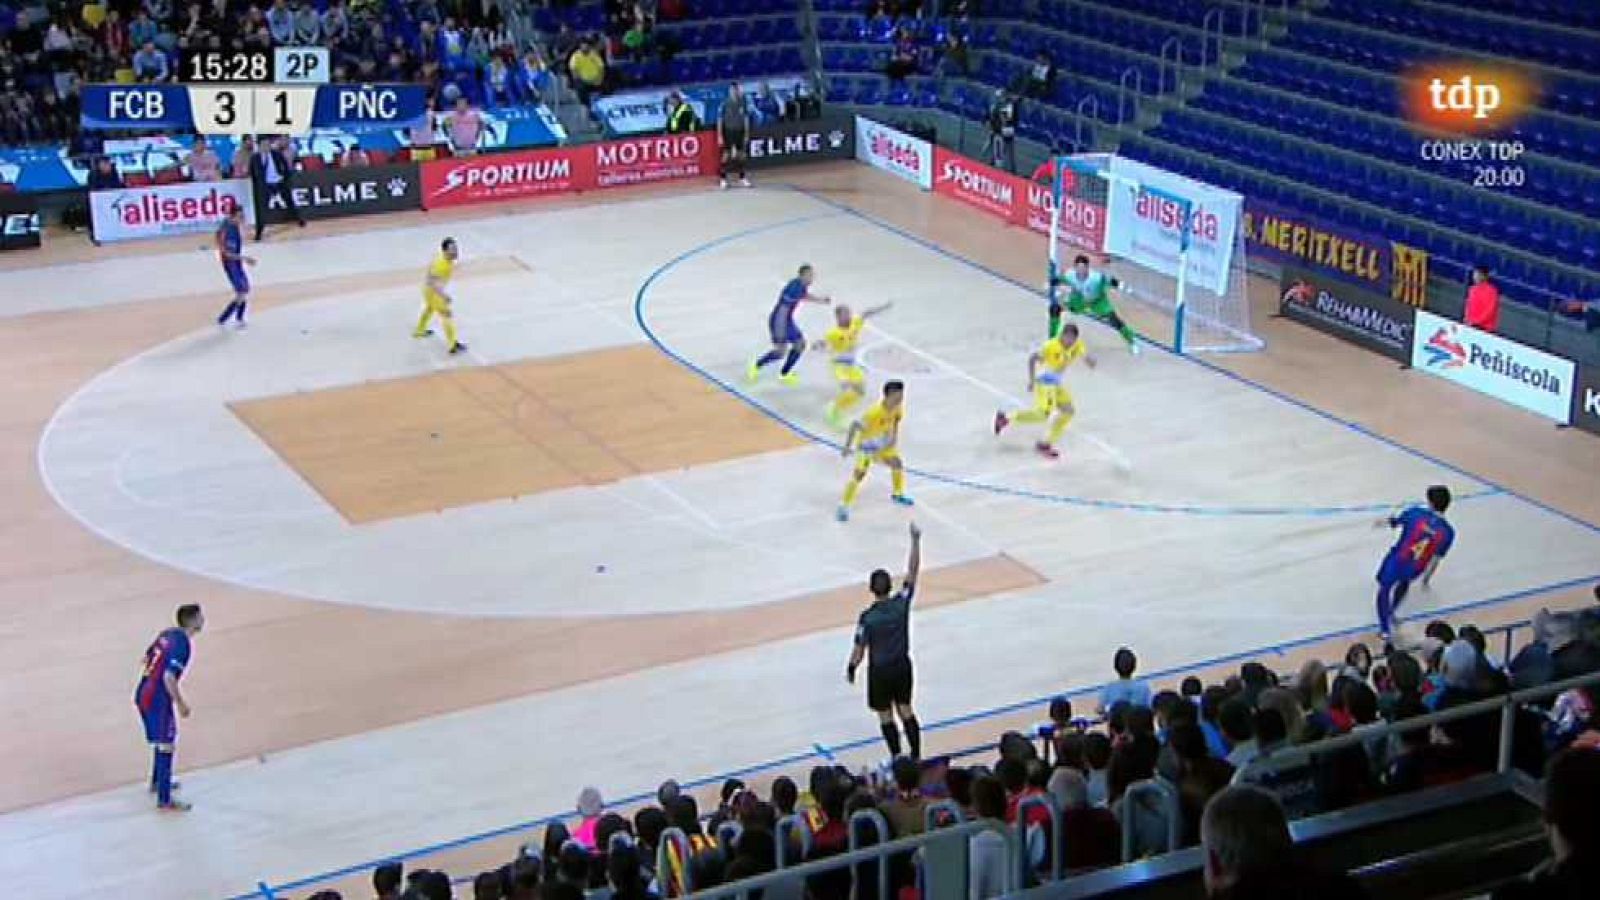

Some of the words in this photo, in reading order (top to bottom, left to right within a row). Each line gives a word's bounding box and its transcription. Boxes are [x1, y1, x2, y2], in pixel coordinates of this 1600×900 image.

[597, 136, 699, 166] MOTRIO
[750, 133, 821, 157] ELME
[440, 158, 570, 192] SPORTIUM
[943, 160, 1013, 205] SPORTIUM
[124, 188, 236, 225] aliseda
[1028, 184, 1095, 228] MORIO
[1261, 215, 1380, 281] MERITXELL
[1468, 342, 1560, 396] Peñiscola
